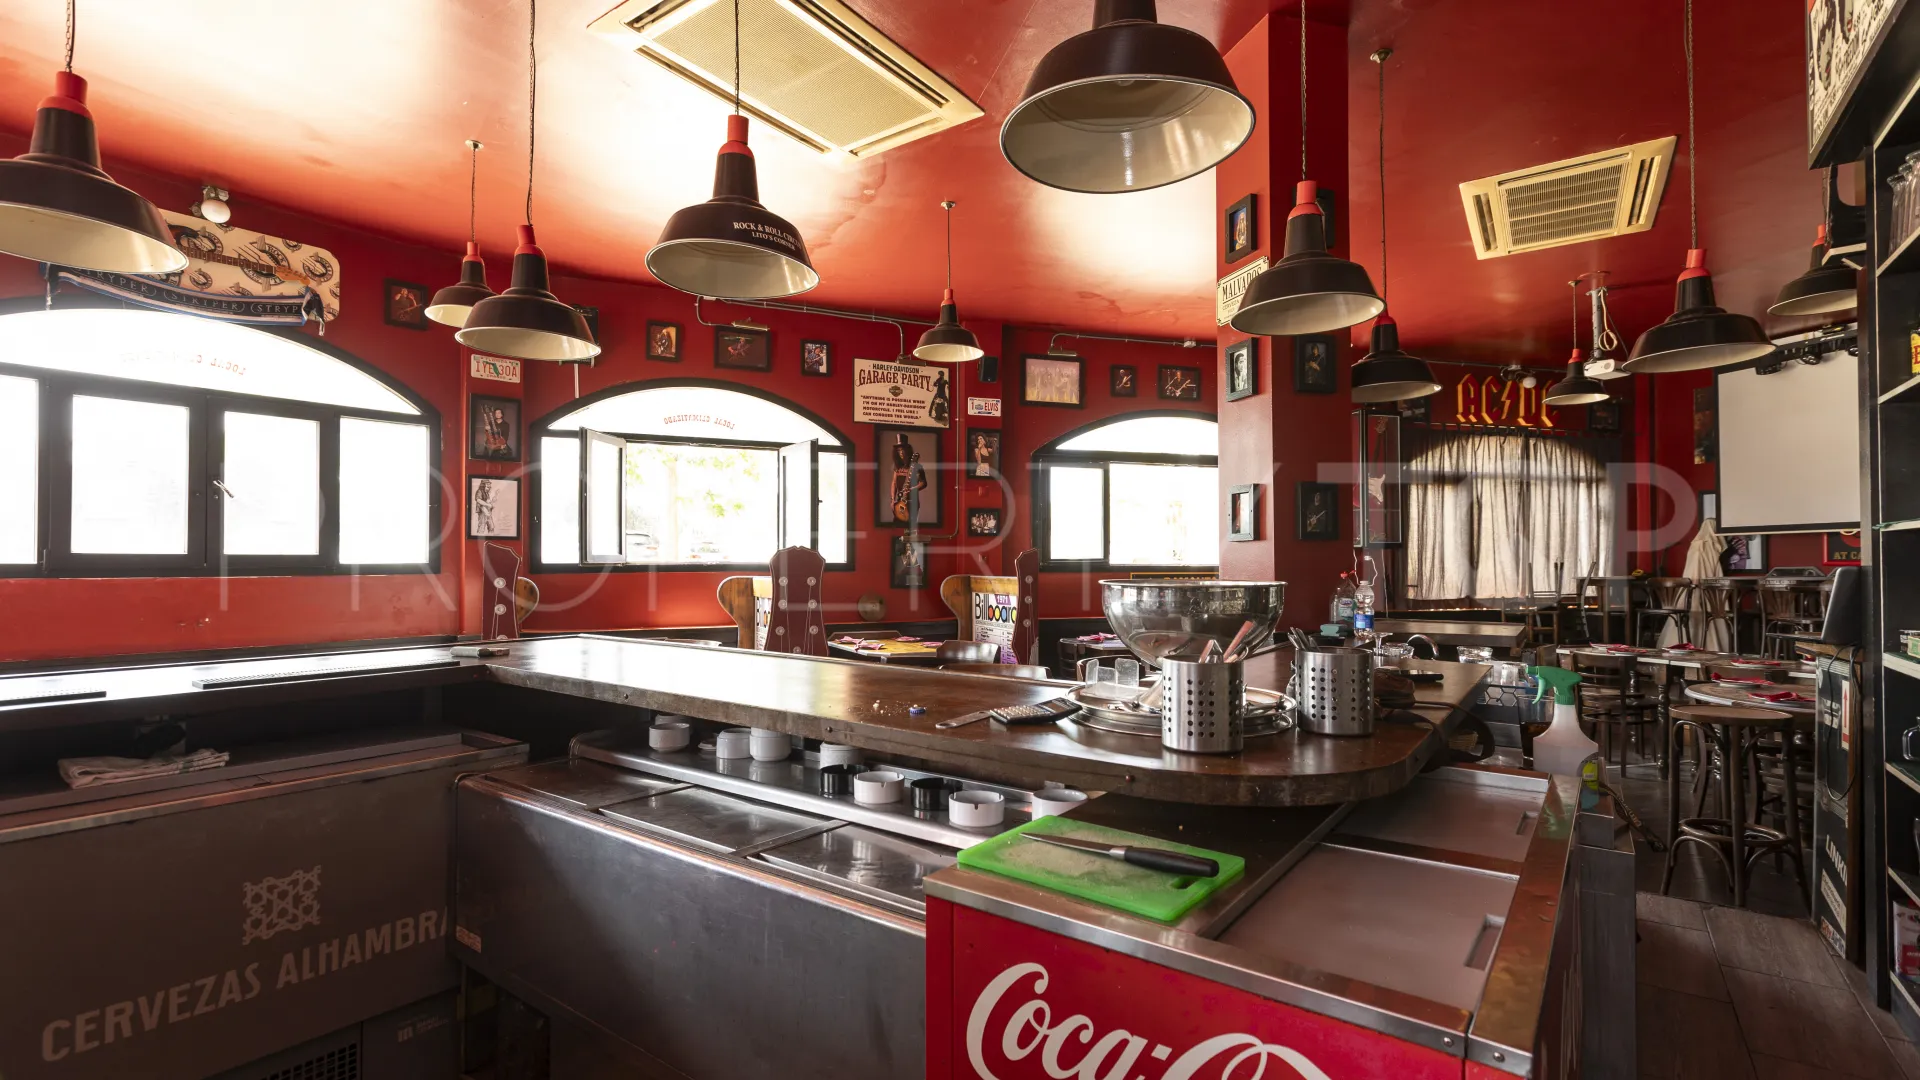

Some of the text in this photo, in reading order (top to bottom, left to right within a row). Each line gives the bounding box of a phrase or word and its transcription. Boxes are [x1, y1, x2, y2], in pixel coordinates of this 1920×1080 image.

[733, 221, 756, 230] ROCK
[757, 223, 764, 232] &
[764, 225, 783, 237] ROLL
[752, 231, 796, 250] LITO'S CORNER
[171, 290, 238, 312] STRYPER
[872, 363, 920, 374] HARLEY-DAVIDSON
[856, 369, 899, 387] GARAGE
[901, 372, 934, 392] PARTY
[984, 402, 998, 412] ELVIS
[1832, 551, 1848, 560] AT
[41, 961, 261, 1063] CERVEZAS
